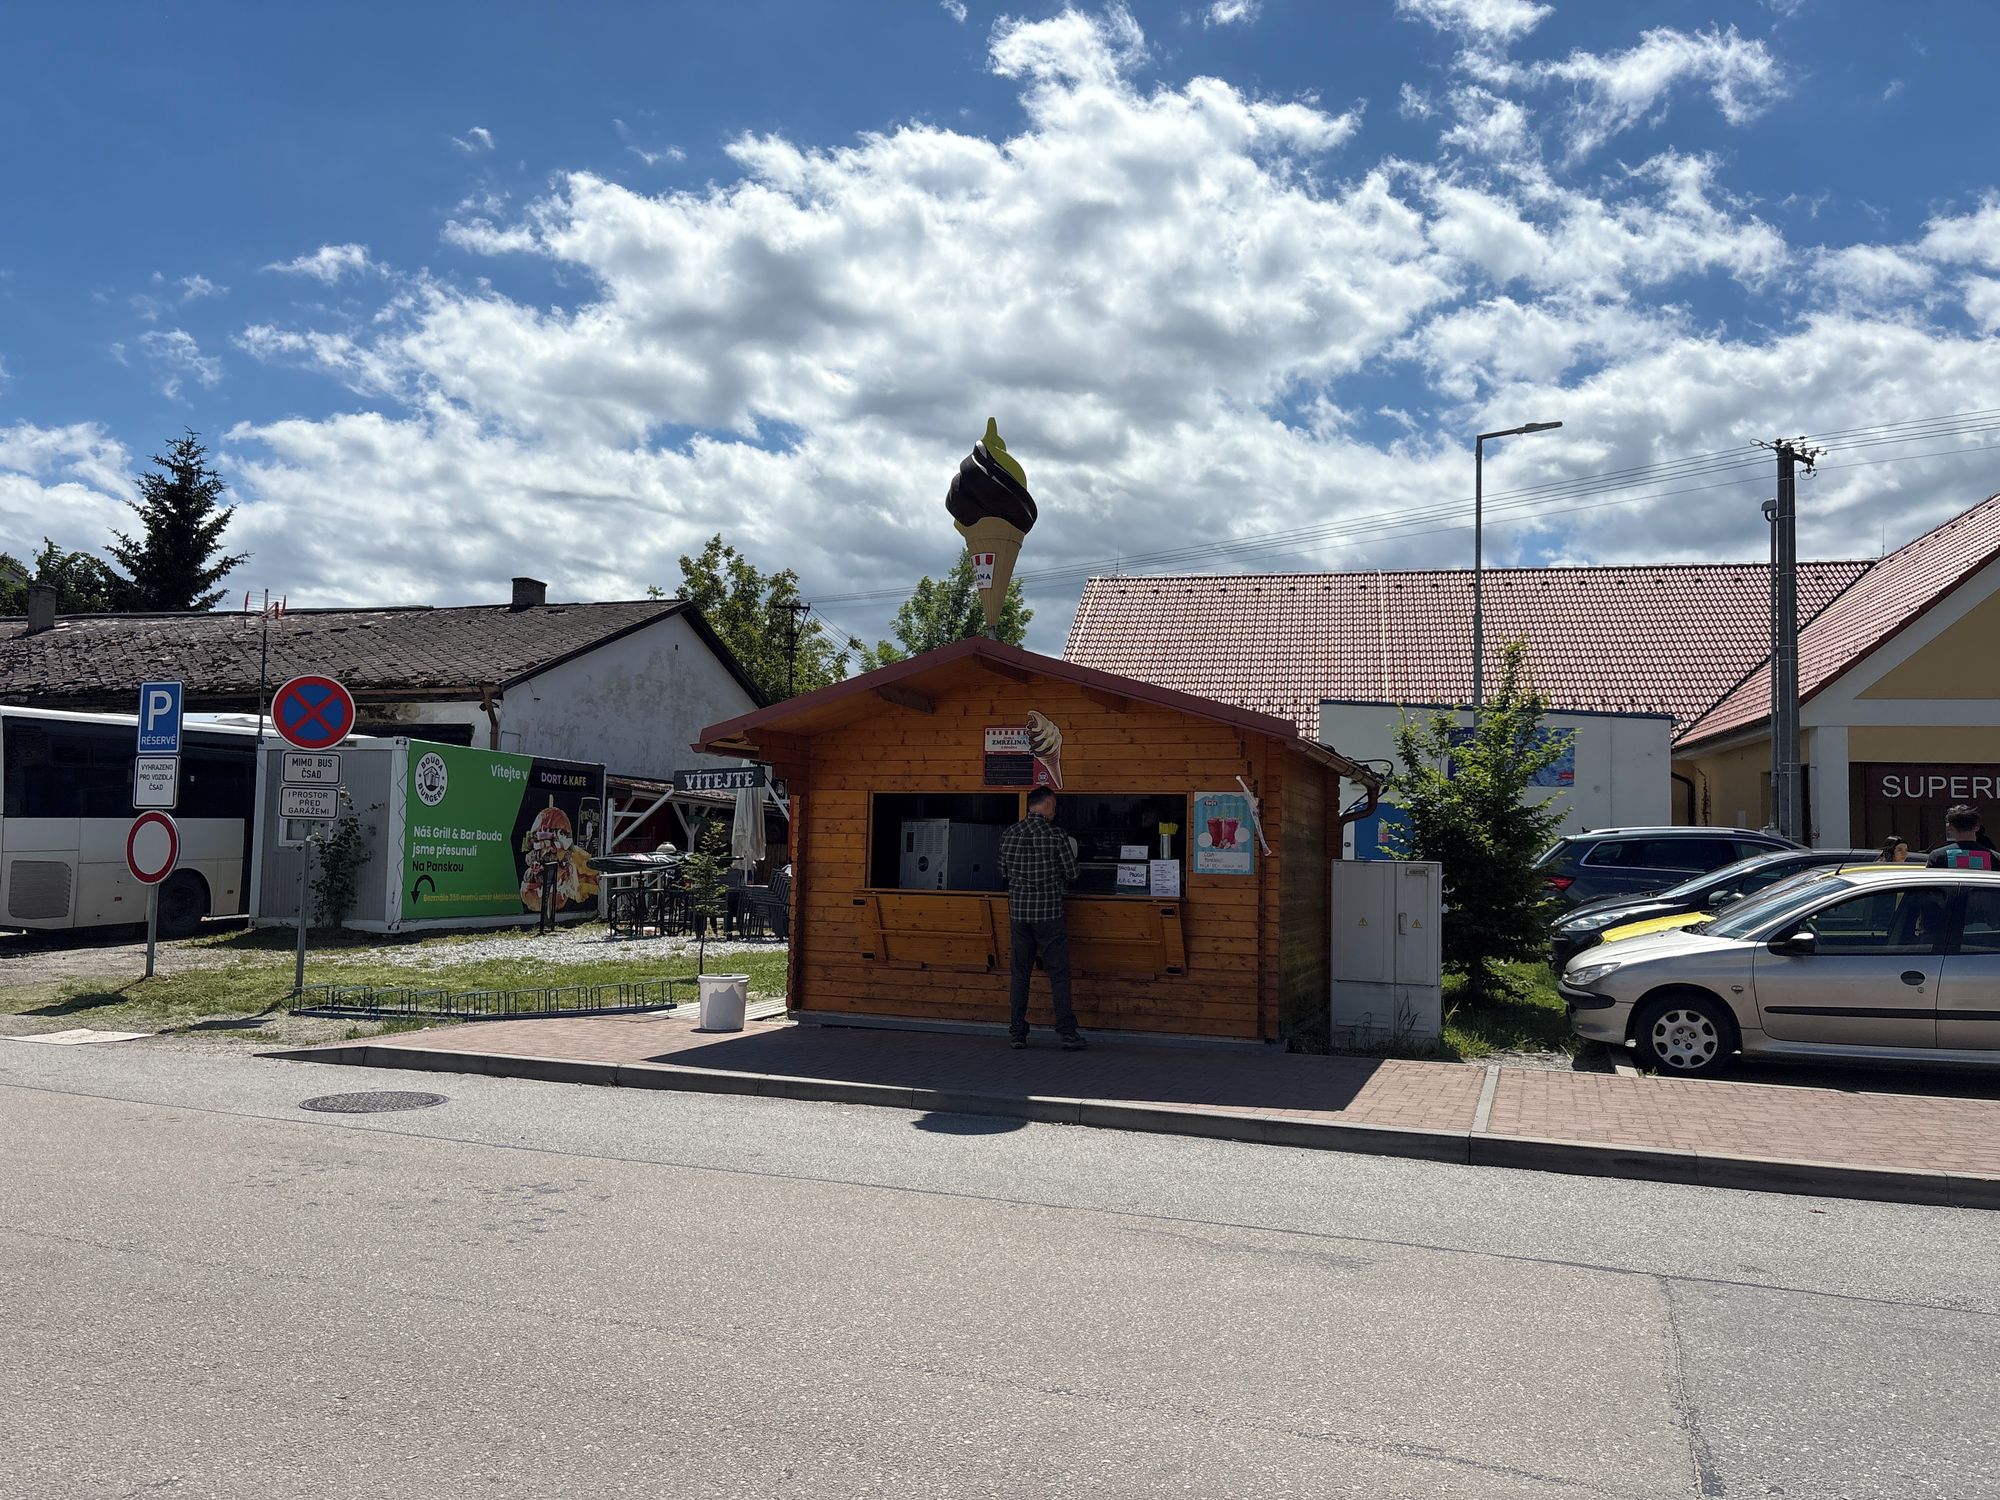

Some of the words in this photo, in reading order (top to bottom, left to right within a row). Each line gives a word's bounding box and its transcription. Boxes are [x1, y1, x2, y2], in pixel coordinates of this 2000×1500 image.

[148, 690, 172, 730] P
[141, 734, 176, 745] RÉSERVÉ
[141, 763, 173, 771] VYHRAZENO
[292, 758, 312, 767] MIMO
[317, 758, 333, 768] BUS
[420, 756, 443, 770] BOUDA
[139, 773, 151, 781] PRO
[152, 773, 173, 781] VOZIDLA
[301, 768, 321, 779] ČSAD
[491, 765, 521, 782] Vítejte
[522, 770, 528, 780] v
[541, 772, 561, 785] DORT
[562, 775, 569, 785] &
[569, 774, 587, 786] KAFE
[684, 770, 754, 789] VÍTEJTE
[149, 782, 164, 791] ČSAD
[1882, 775, 2000, 799] SUPER
[292, 791, 328, 799] PROSTOR
[418, 784, 446, 802] BURGERS
[299, 798, 321, 806] PŘED
[288, 806, 329, 815] GARÁŽEMI
[414, 826, 432, 838] Náš
[433, 827, 450, 839] Grill
[452, 831, 459, 840] &
[460, 829, 475, 841] Bar
[476, 829, 502, 841] Bouda
[412, 844, 435, 858] jsme
[436, 843, 477, 858] přesunuli
[412, 861, 424, 871] Na
[426, 861, 464, 872] Panskou
